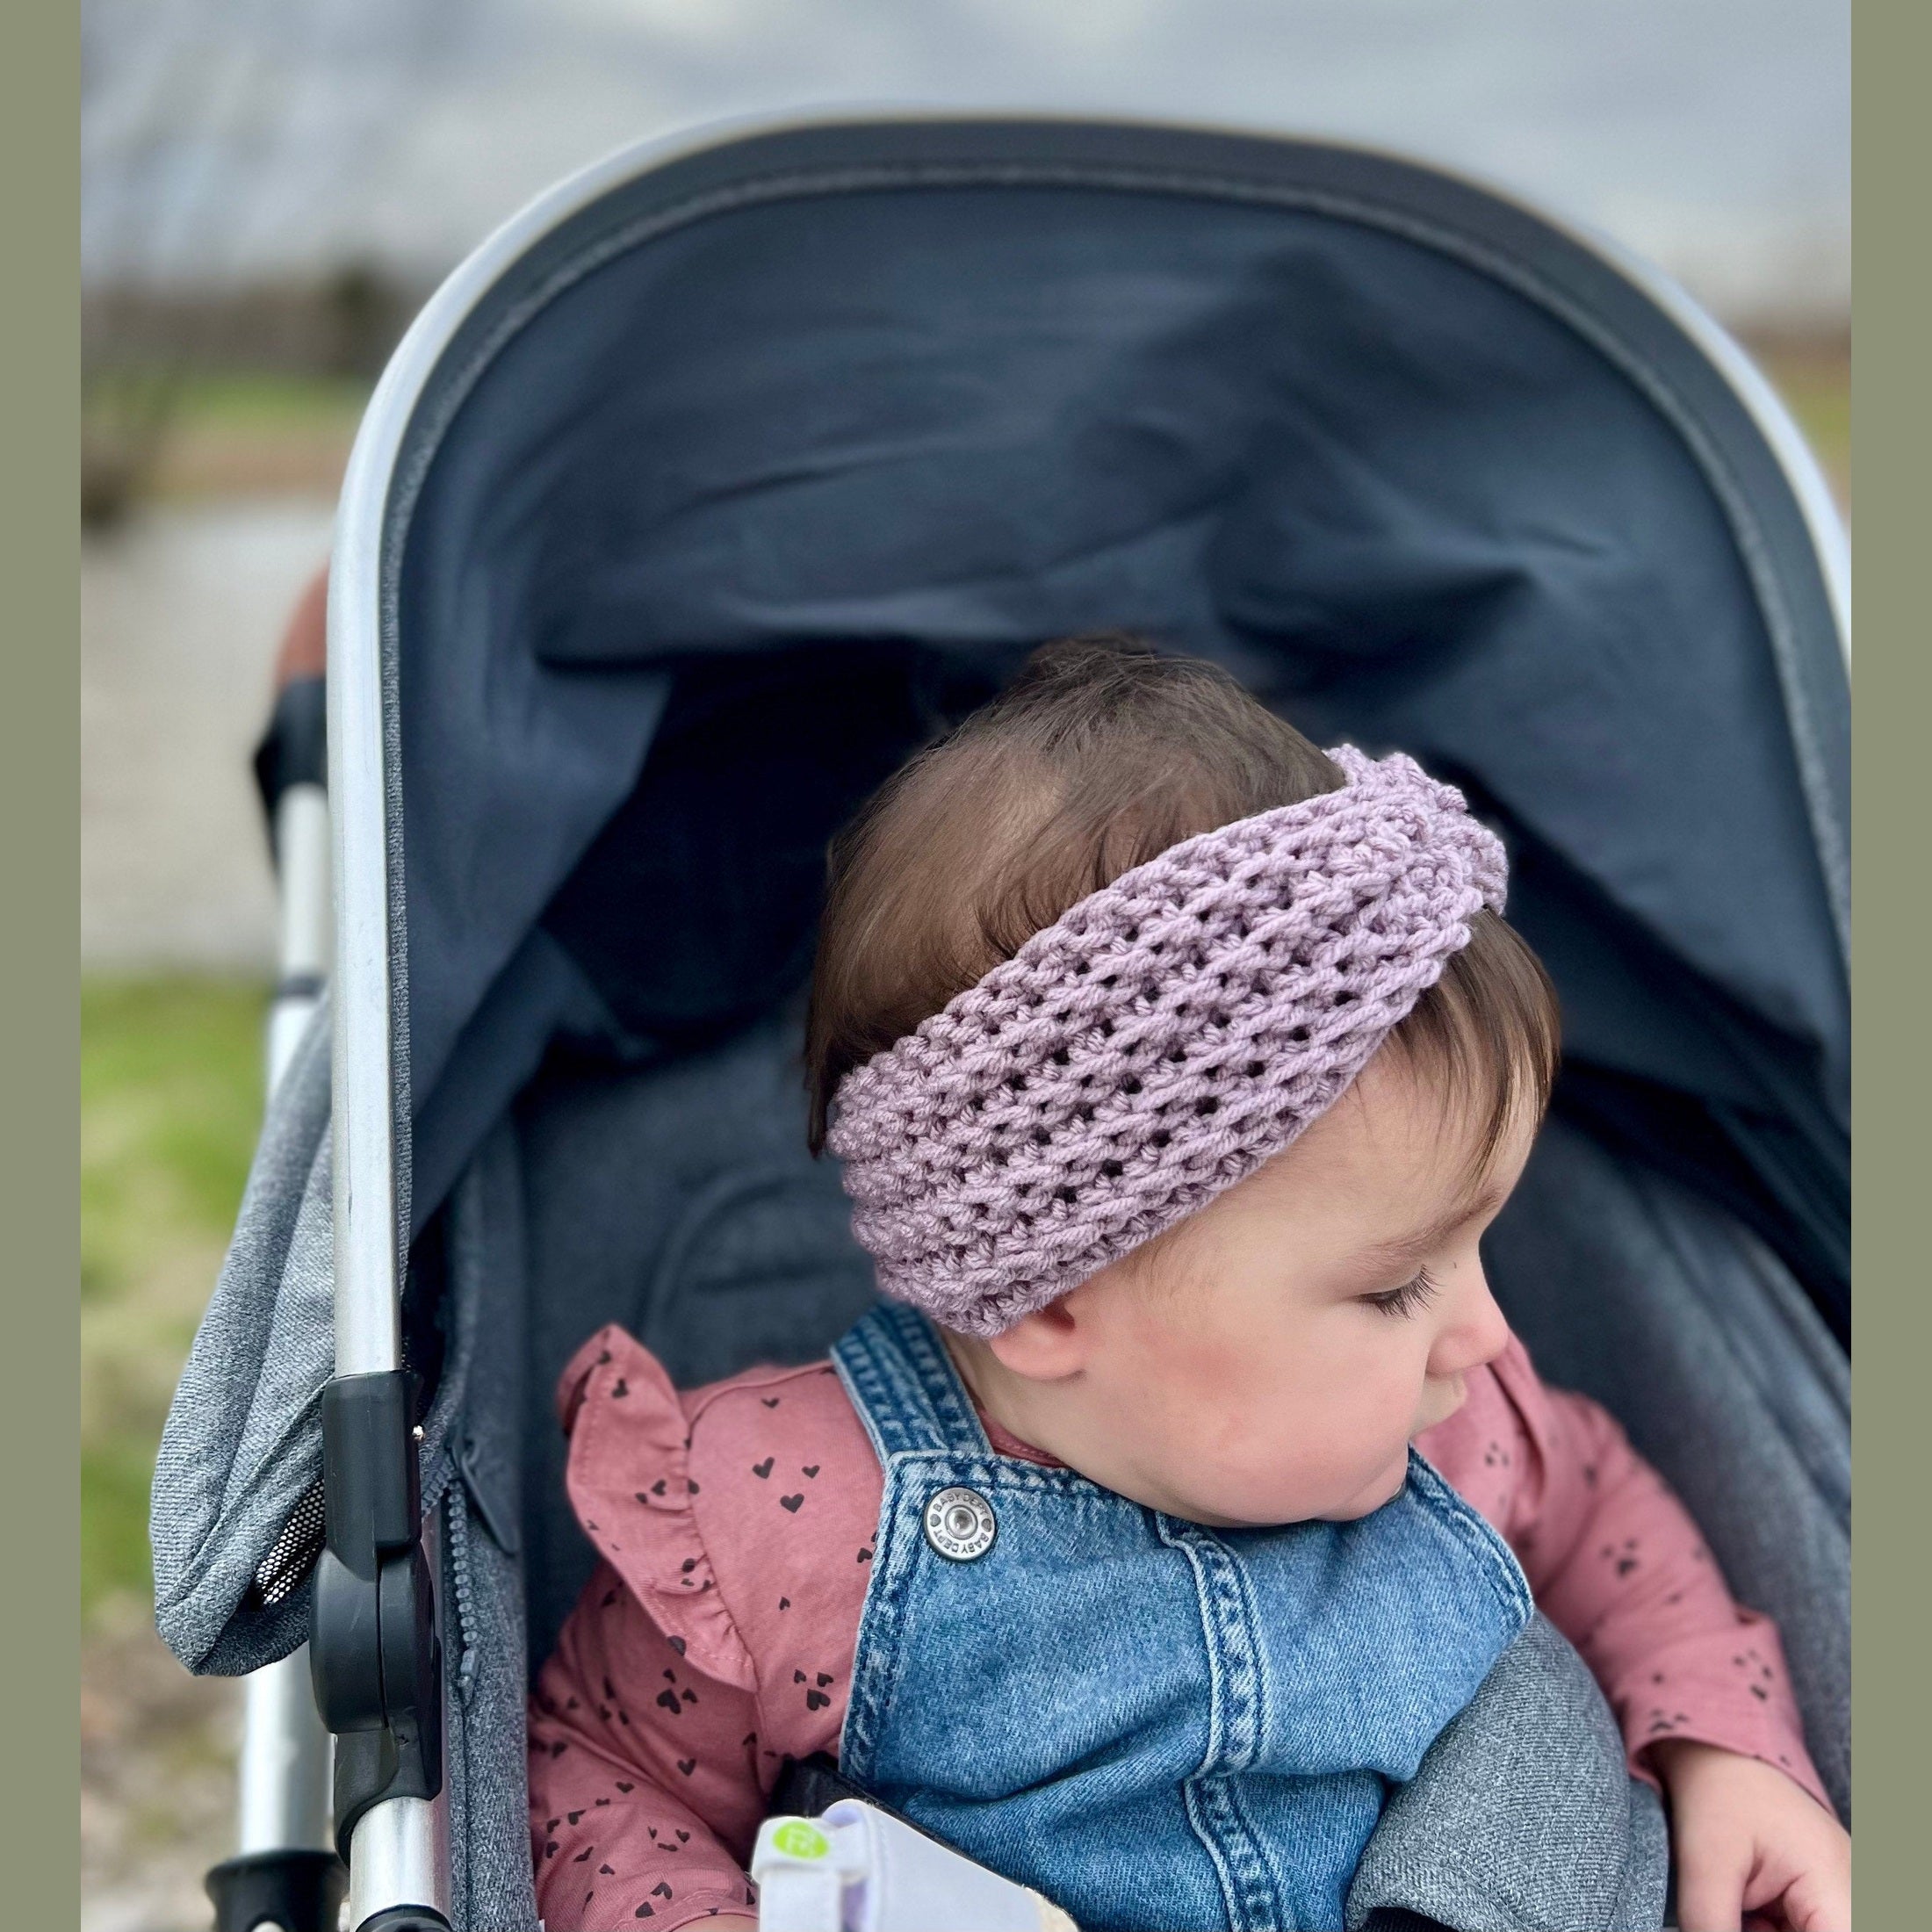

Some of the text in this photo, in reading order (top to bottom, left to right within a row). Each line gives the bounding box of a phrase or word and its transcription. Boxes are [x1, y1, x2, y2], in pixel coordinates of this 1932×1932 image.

[934, 1493, 961, 1512] BABY
[934, 1529, 990, 1554] BABY DEPT
